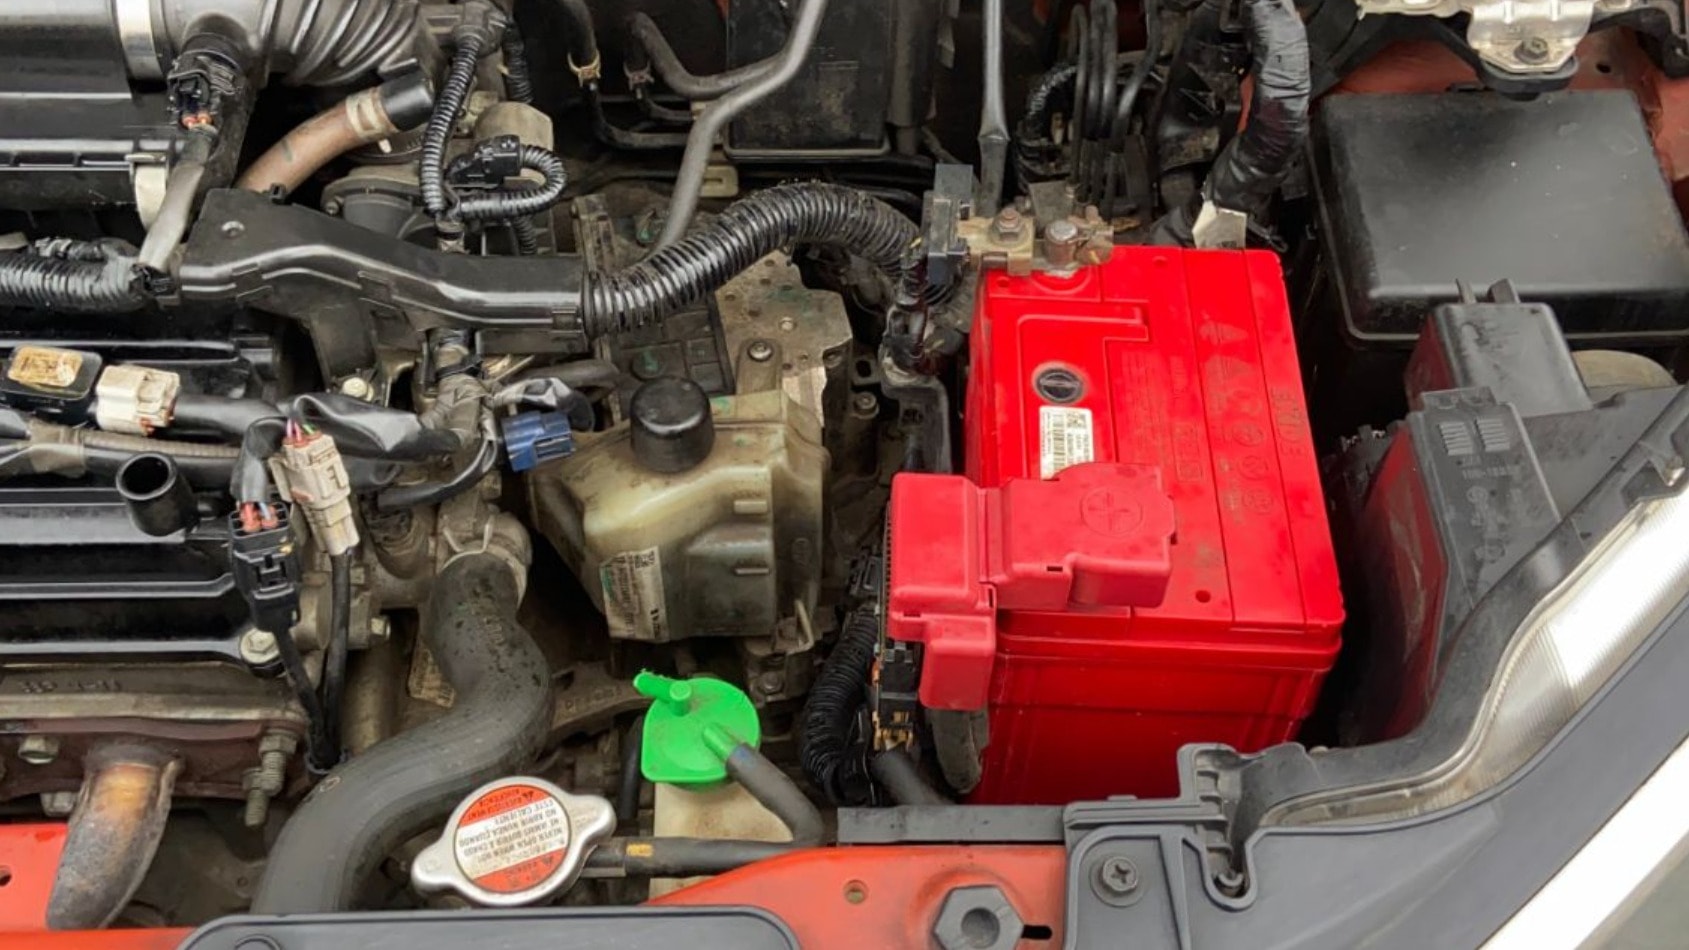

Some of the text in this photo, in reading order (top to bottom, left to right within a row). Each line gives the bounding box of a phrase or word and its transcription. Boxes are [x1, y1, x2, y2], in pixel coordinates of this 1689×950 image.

[493, 806, 532, 825] CALIENTE
[458, 807, 557, 848] NO ABRIR NUNCA CUANDO
[537, 826, 562, 842] NEVER
[492, 843, 516, 857] WHEN
[516, 835, 537, 849] OPEN
